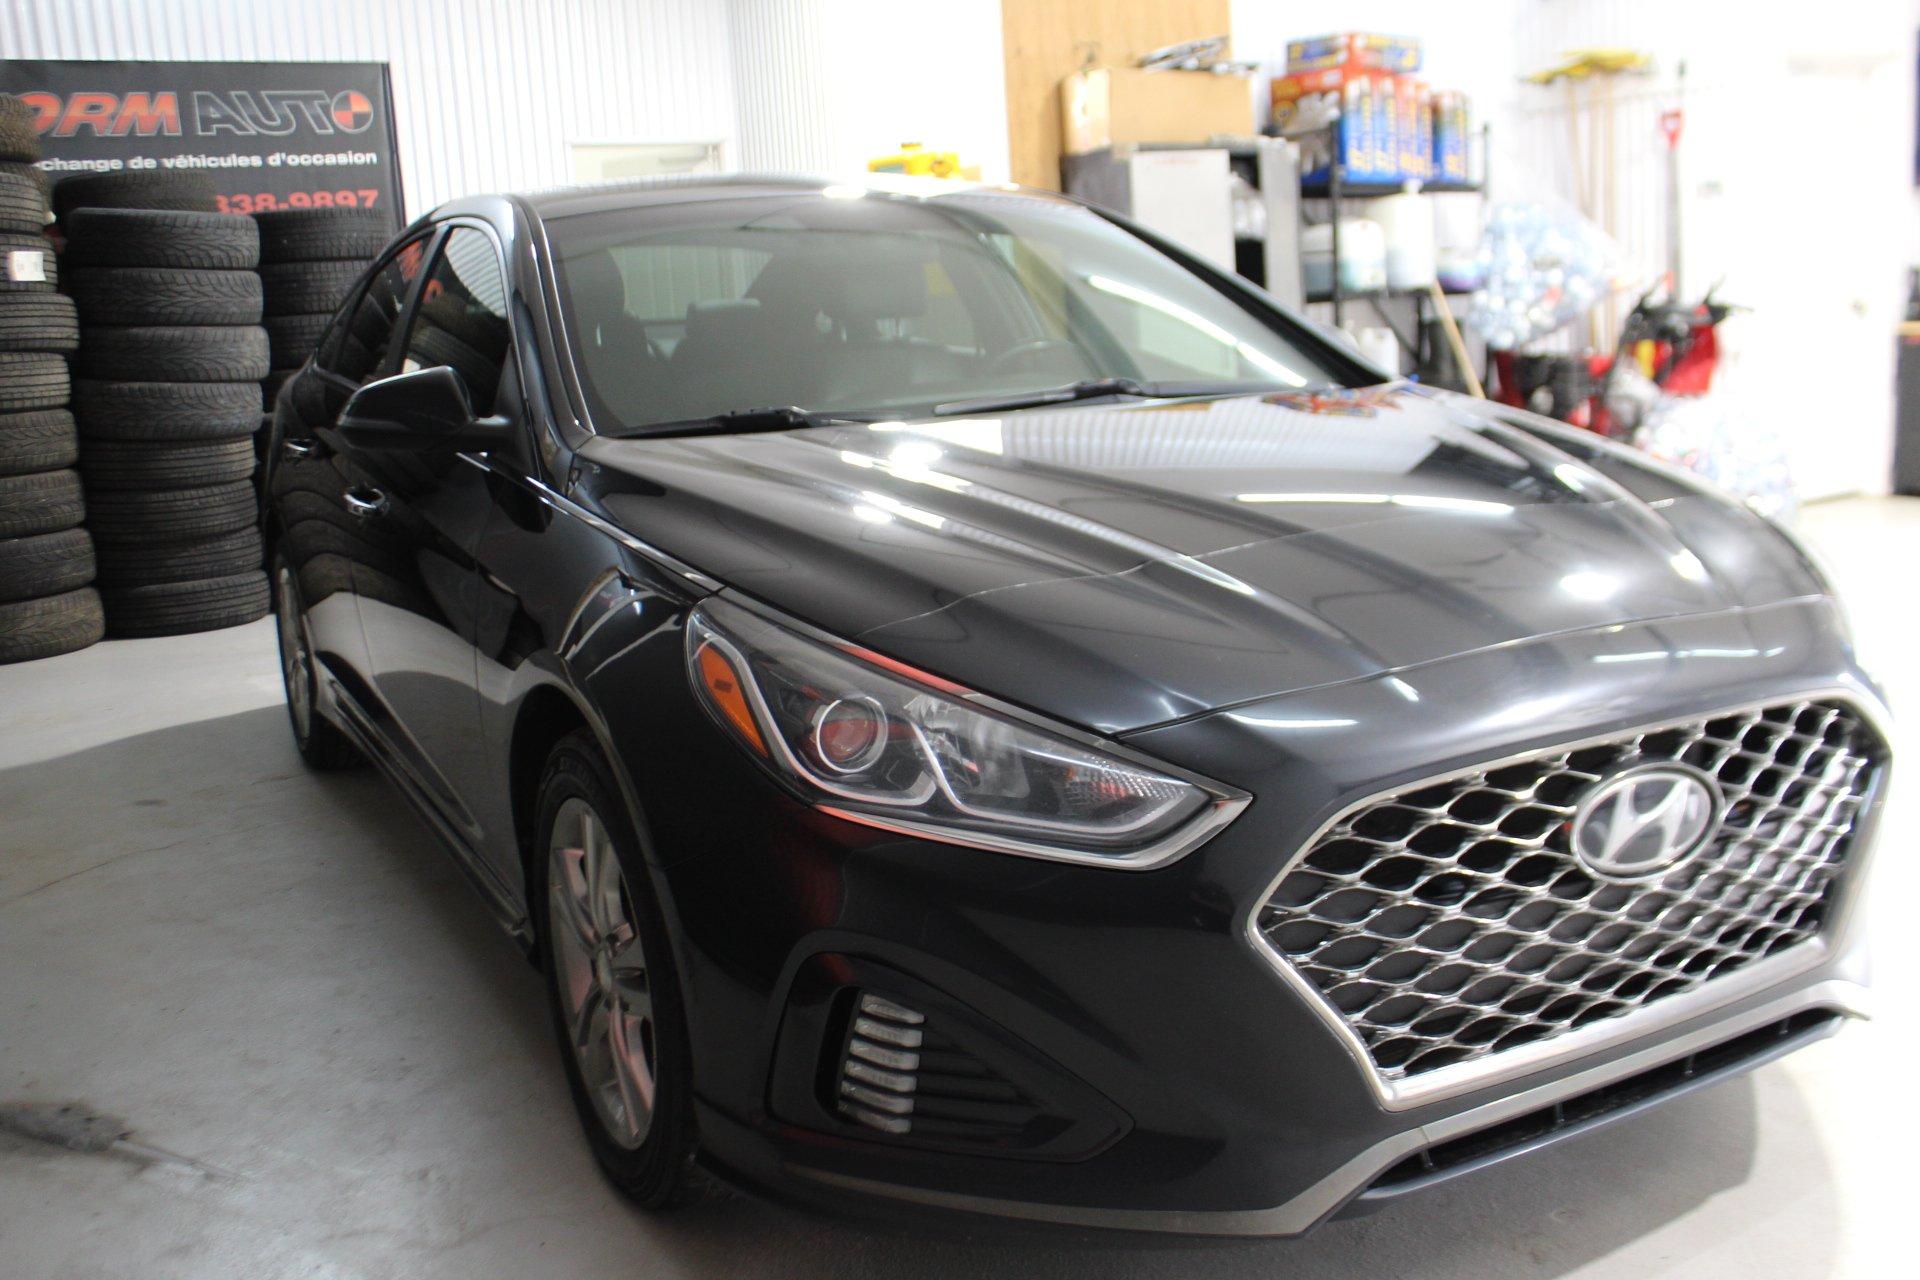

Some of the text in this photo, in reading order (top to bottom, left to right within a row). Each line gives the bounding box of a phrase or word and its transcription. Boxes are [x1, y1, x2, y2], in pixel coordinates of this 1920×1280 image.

[126, 155, 157, 169] de
[161, 153, 263, 170] véhicules
[267, 150, 378, 168] d'occasion
